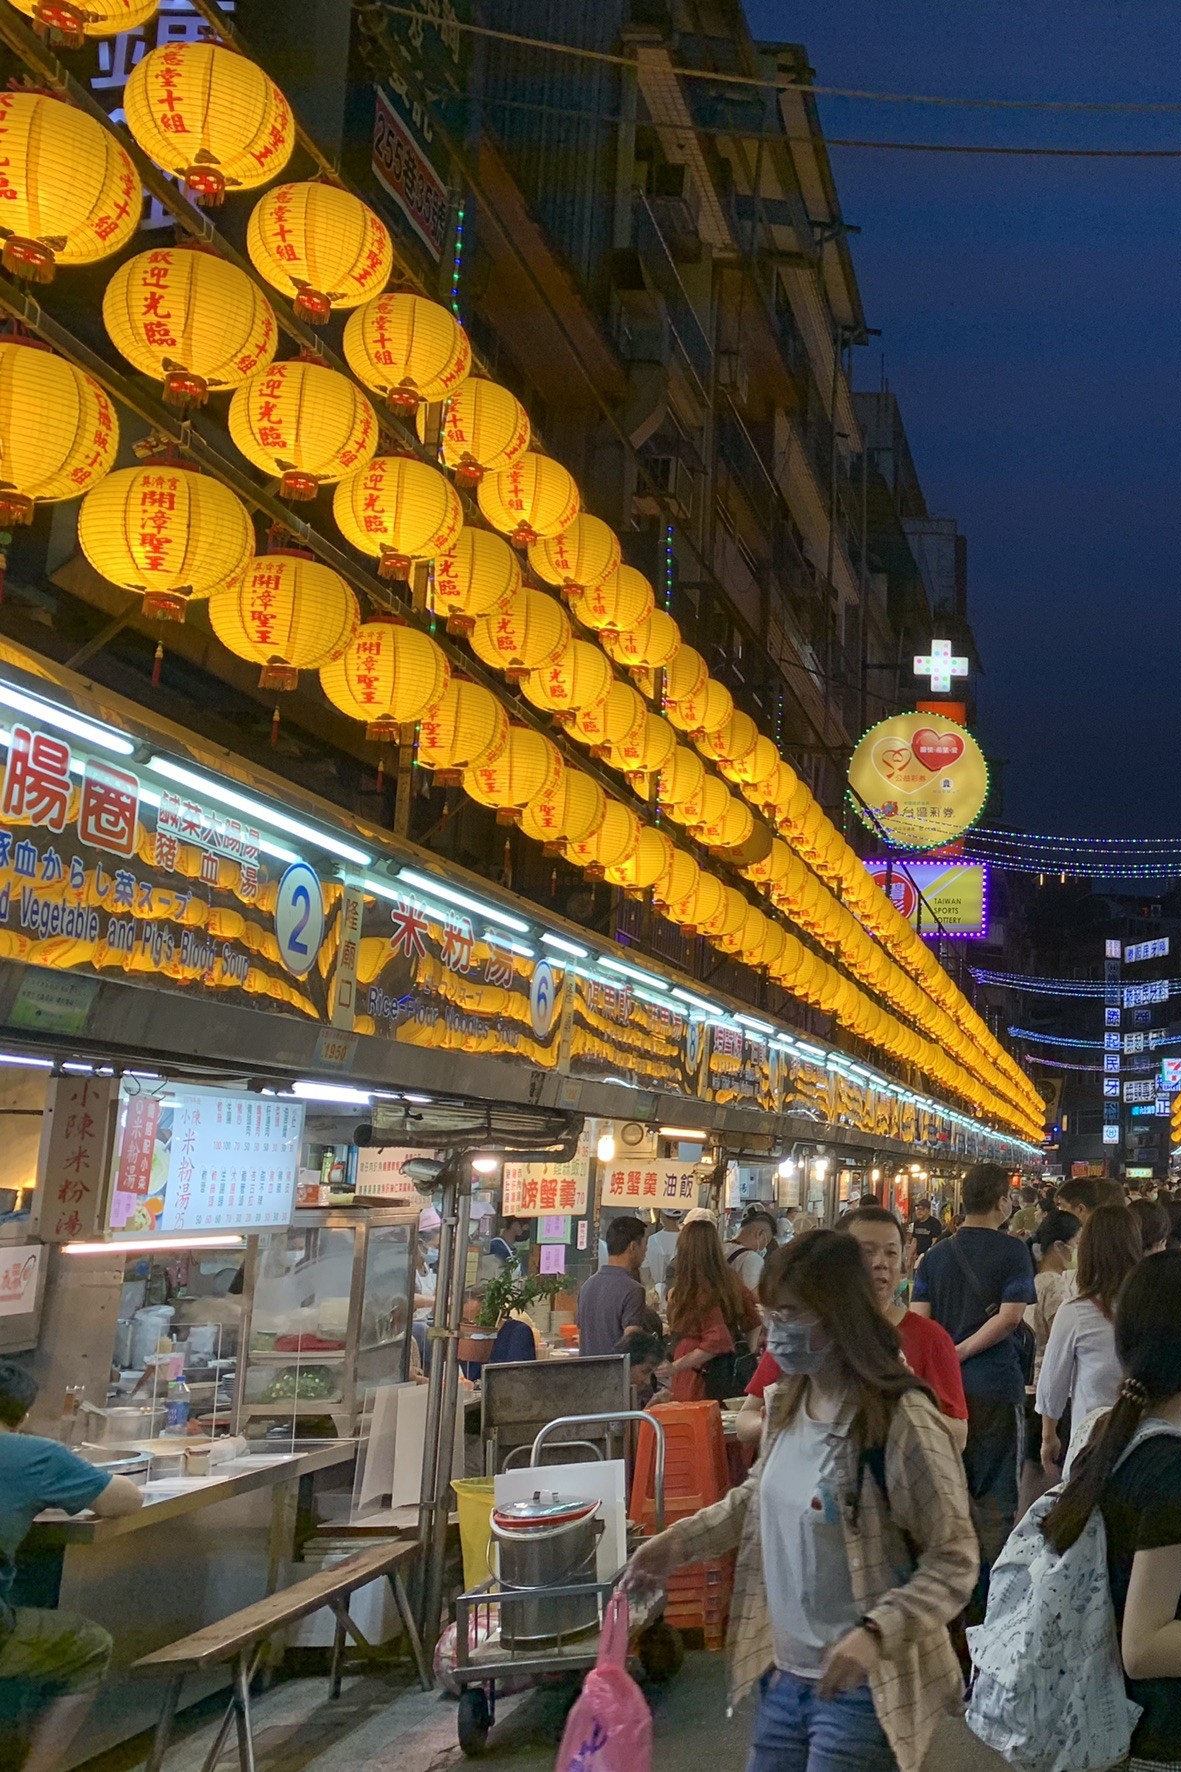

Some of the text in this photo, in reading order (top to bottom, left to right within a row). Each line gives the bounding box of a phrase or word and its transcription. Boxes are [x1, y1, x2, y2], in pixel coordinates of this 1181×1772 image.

[139, 490, 177, 574] 開漳聖王
[250, 574, 281, 646] 開漳聖王
[356, 641, 384, 705] 開漳聖王
[156, 831, 259, 898] 豬血湯
[22, 888, 101, 943] Vegetable
[108, 916, 136, 953] and
[142, 922, 175, 969] Pig's
[181, 931, 217, 969] Blood
[222, 942, 250, 983] Soup
[287, 884, 312, 956] 2
[390, 891, 514, 989] 米粉湯
[536, 974, 551, 1020] 6
[56, 1081, 100, 1237] 小陳米粉湯
[174, 1128, 196, 1211] 米粉湯
[609, 1170, 694, 1198] 螃蟹羹 油飯
